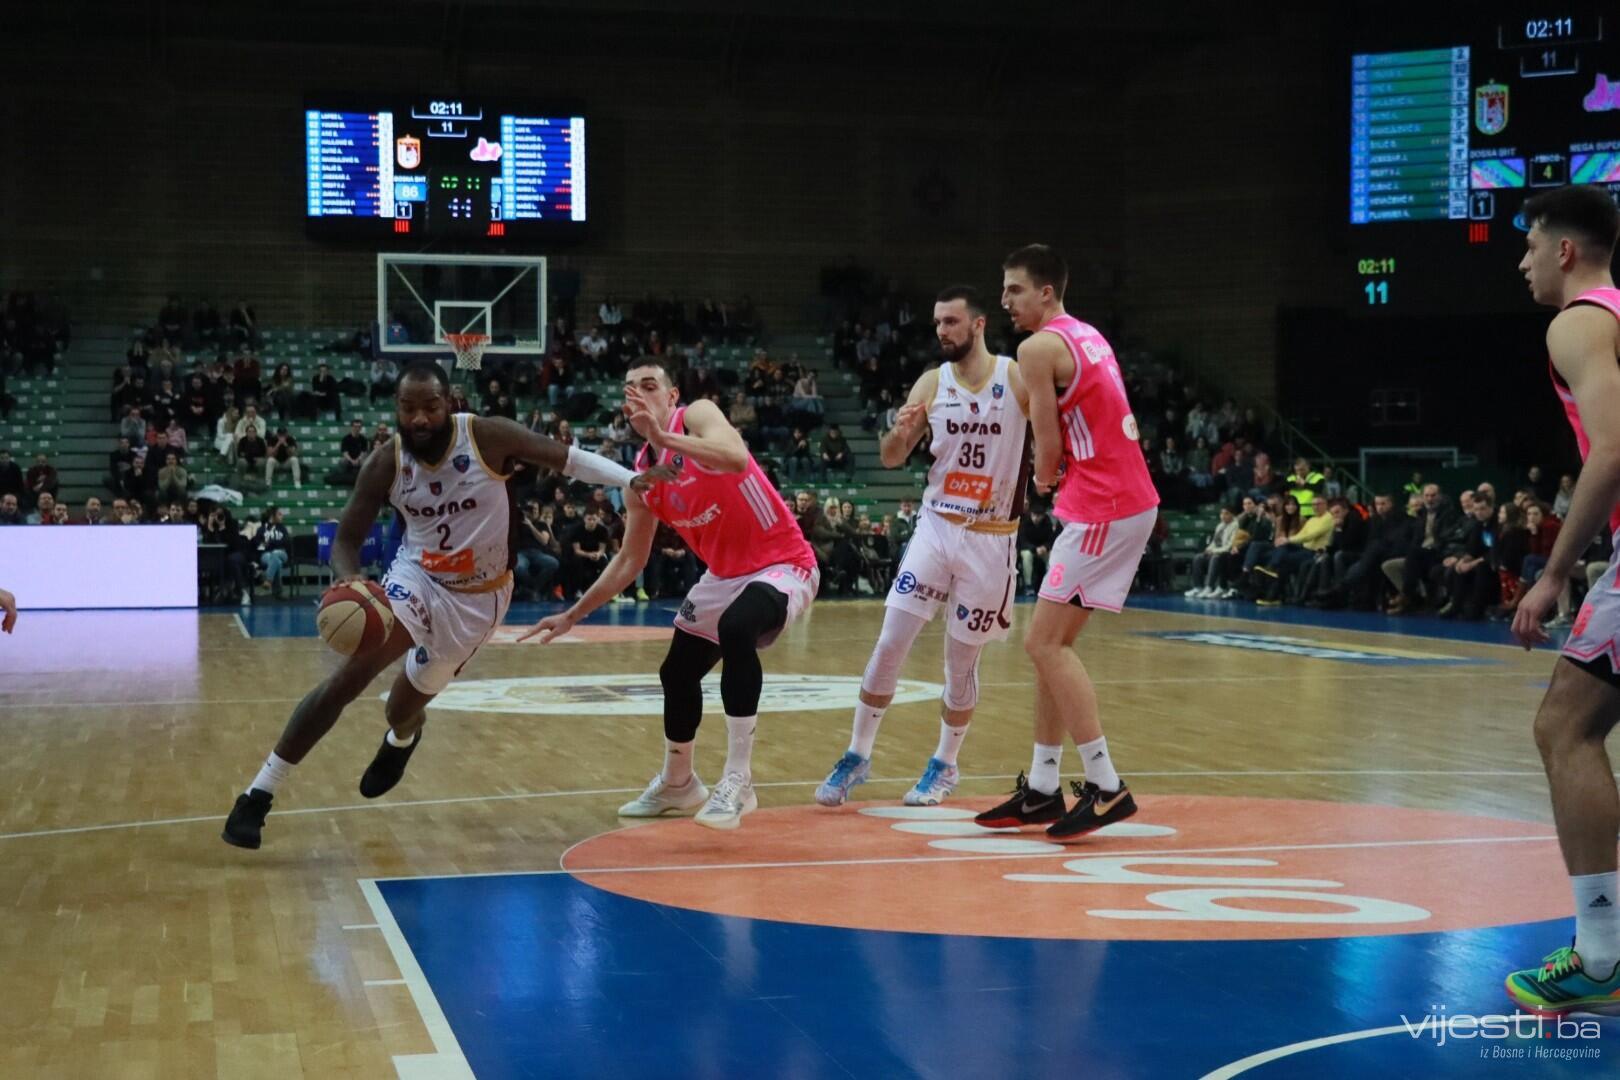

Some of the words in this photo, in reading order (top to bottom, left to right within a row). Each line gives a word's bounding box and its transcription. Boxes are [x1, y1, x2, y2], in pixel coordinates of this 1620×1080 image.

[1526, 18, 1572, 38] 02:11
[1542, 50, 1557, 68] 11
[430, 102, 463, 115] 02:11
[441, 121, 453, 133] 11
[1543, 164, 1553, 179] 4
[401, 185, 419, 198] 86
[400, 206, 406, 217] 1
[1358, 258, 1395, 274] 02:11
[1365, 281, 1388, 304] 11
[946, 419, 1002, 435] bosna
[958, 442, 986, 469] 35
[404, 498, 477, 517] bosna
[437, 523, 453, 550] 2
[967, 608, 997, 633] 35
